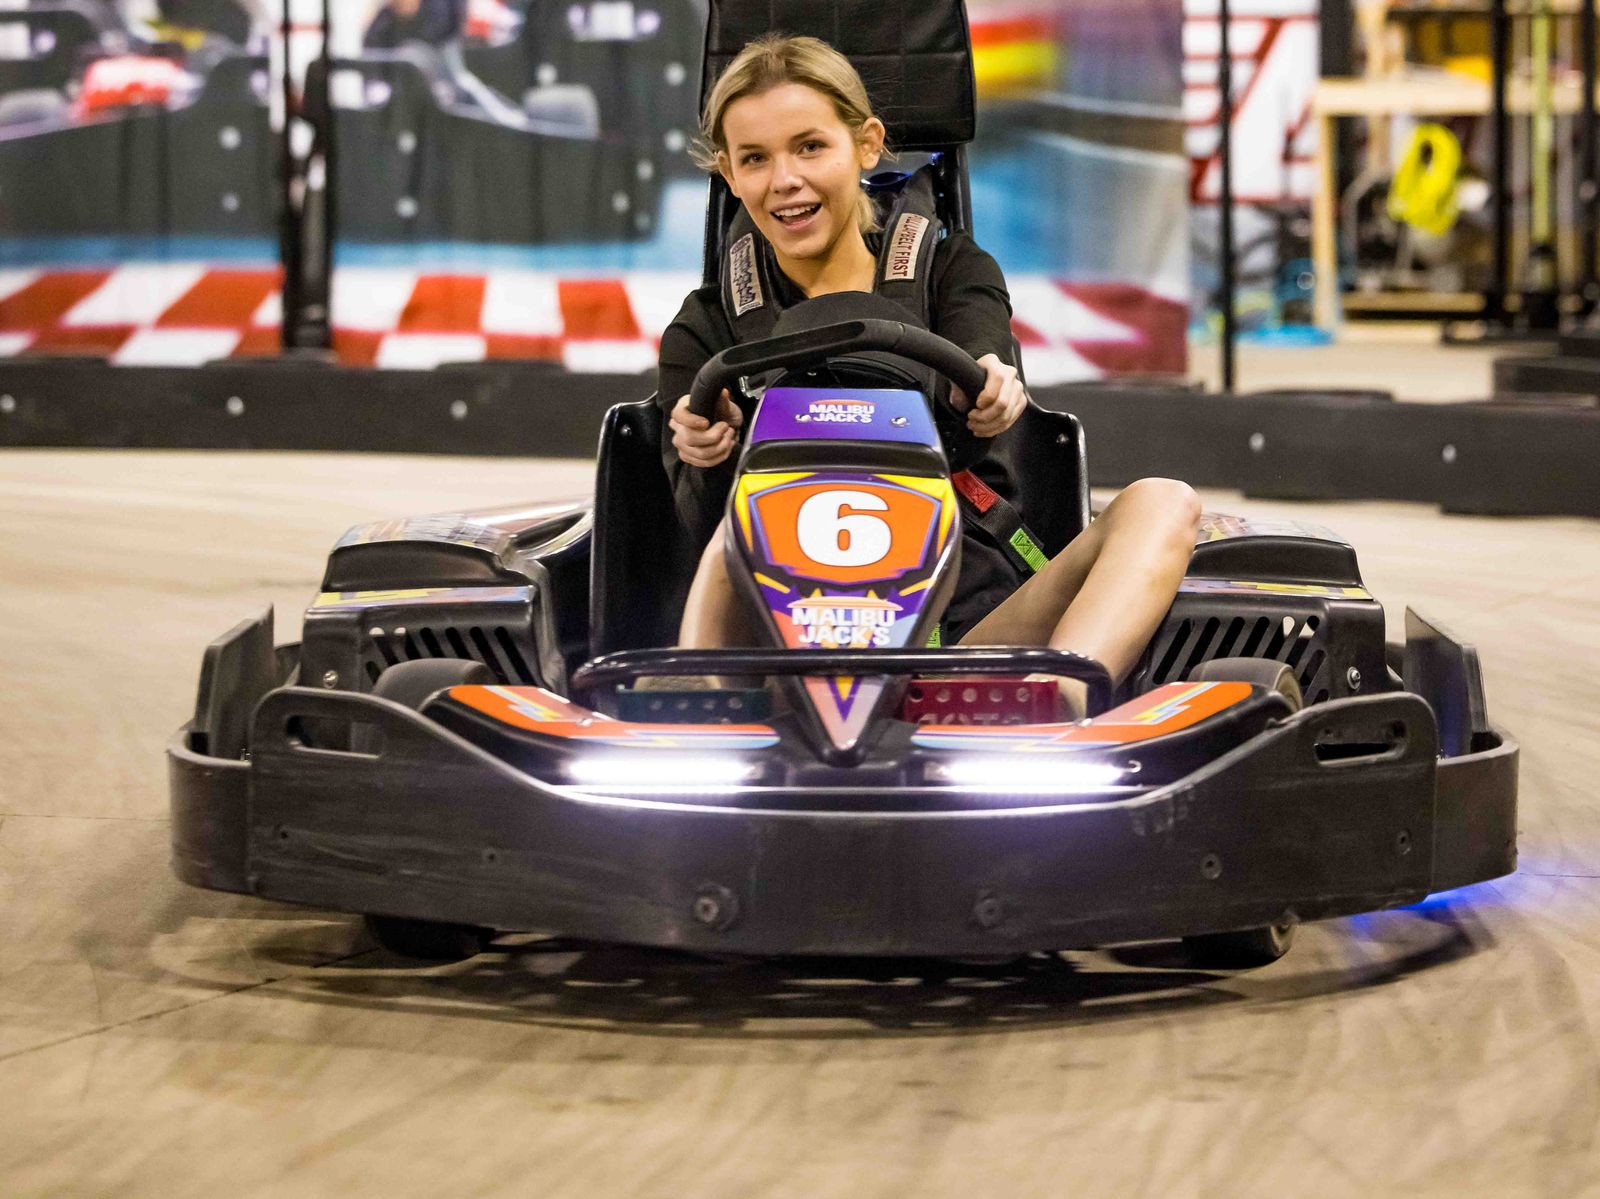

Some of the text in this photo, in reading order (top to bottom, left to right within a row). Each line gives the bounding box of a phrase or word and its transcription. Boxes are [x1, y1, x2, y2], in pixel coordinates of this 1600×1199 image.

[892, 251, 911, 277] FIRST
[809, 404, 875, 414] MALIBU
[813, 413, 873, 424] JACK'S
[797, 490, 892, 567] 6
[791, 608, 896, 627] MALIBU
[798, 626, 891, 646] JACK'S
